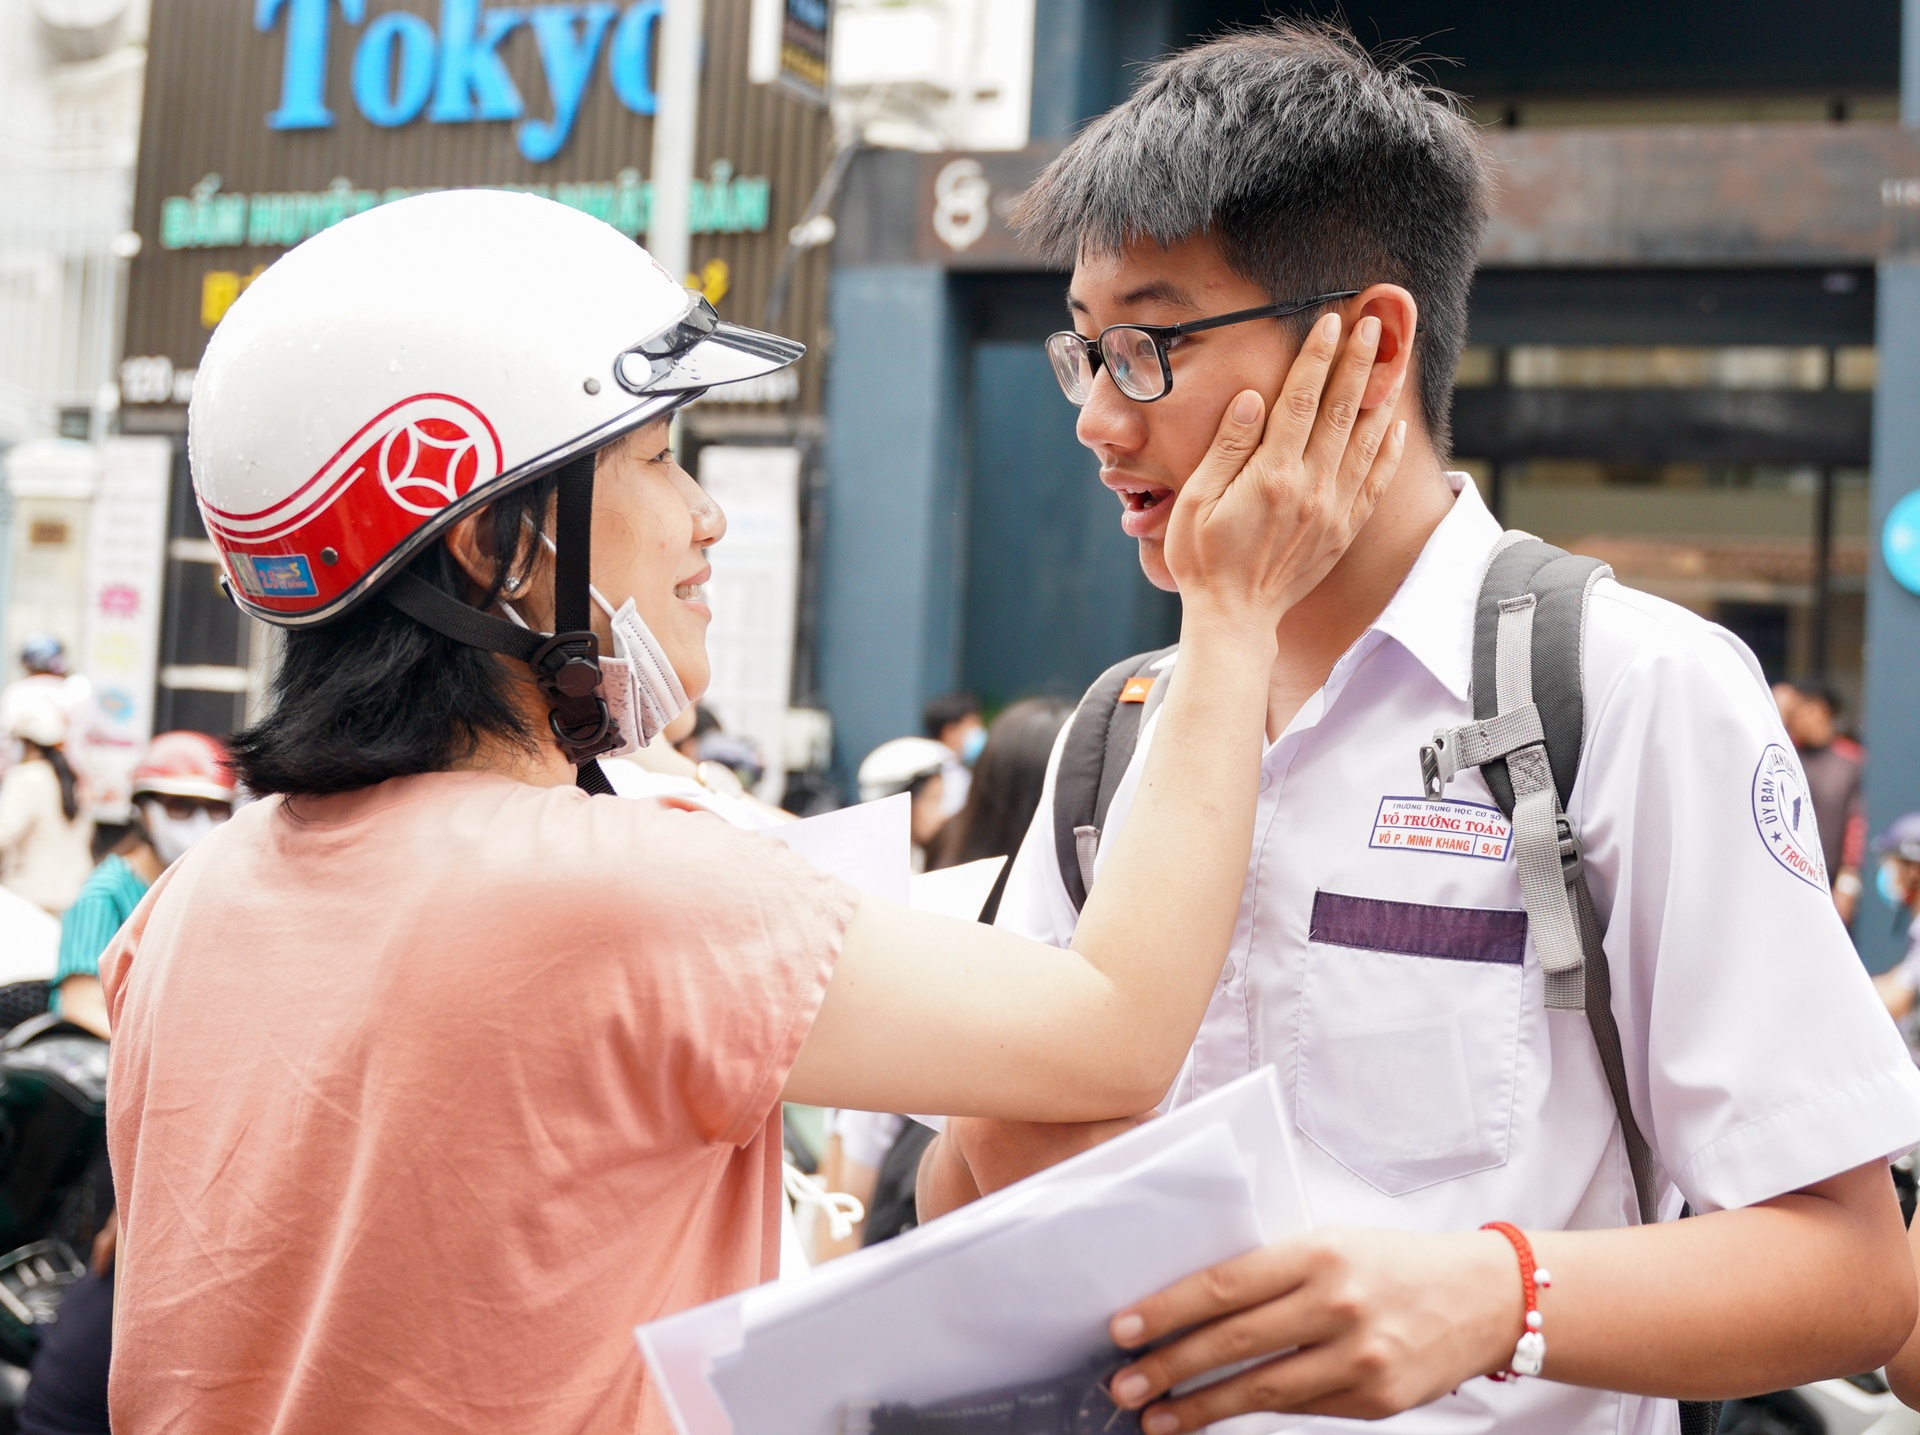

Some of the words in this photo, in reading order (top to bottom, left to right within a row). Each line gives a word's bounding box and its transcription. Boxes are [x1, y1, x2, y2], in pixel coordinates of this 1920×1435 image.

[254, 0, 661, 162] Tokyo
[1761, 778, 1775, 803] BAN
[1382, 811, 1400, 825] VÕ
[1403, 813, 1461, 830] TRƯỜNG
[1425, 804, 1451, 813] TRUNG
[1454, 807, 1472, 815] HỌC
[1475, 810, 1487, 818] CƠ
[1759, 808, 1778, 825] ỦY
[1394, 833, 1403, 845] P.
[1406, 834, 1433, 847] MINH
[1435, 837, 1471, 852] KHANG
[1481, 842, 1503, 856] 9/6
